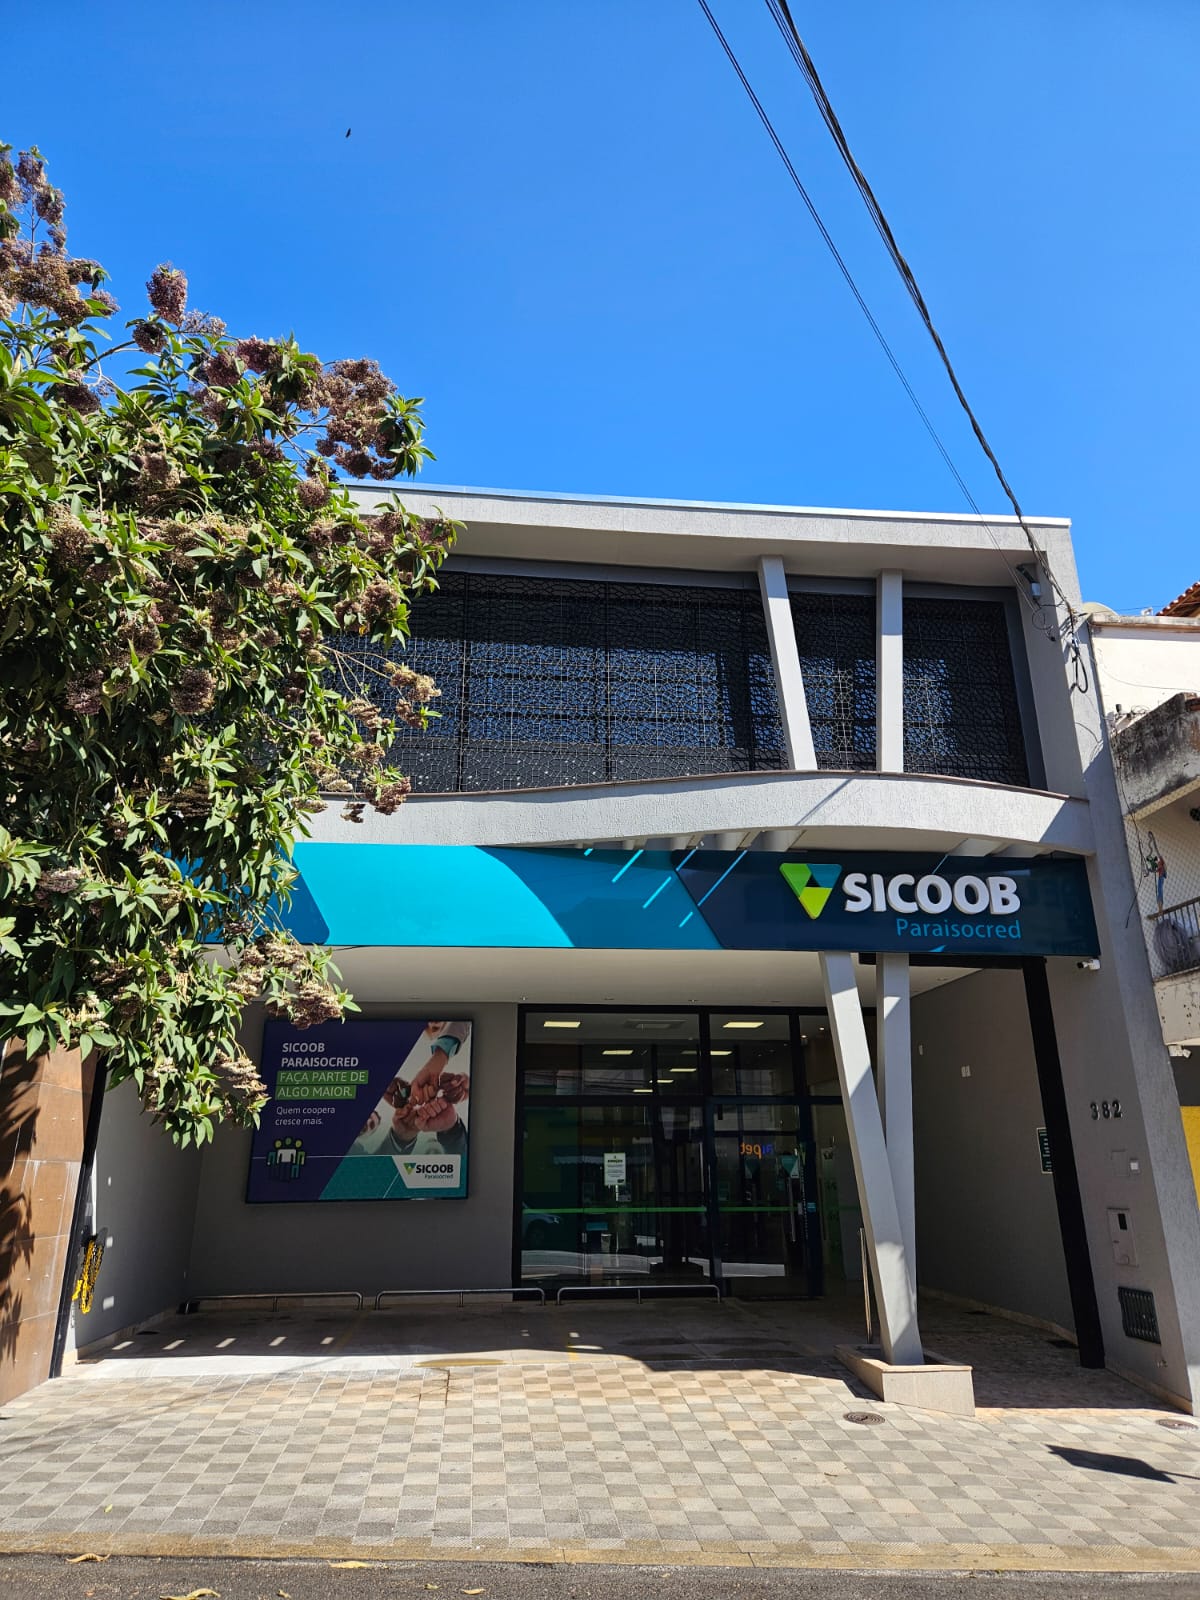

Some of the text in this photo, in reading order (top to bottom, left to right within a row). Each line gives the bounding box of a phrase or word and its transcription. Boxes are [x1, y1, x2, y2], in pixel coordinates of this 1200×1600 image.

[842, 872, 1021, 915] SICOOB
[896, 918, 1021, 939] Paraisocred
[282, 1042, 325, 1053] SICOOB
[281, 1057, 359, 1067] PARAISOCRED
[279, 1071, 366, 1084] FAÇA PARTE DE
[277, 1086, 353, 1098] ALGO MAIOR.
[276, 1106, 336, 1116] Quem coopera
[1090, 1100, 1122, 1120] 382
[275, 1116, 324, 1126] cresce mais.
[415, 1164, 454, 1174] SICOOB
